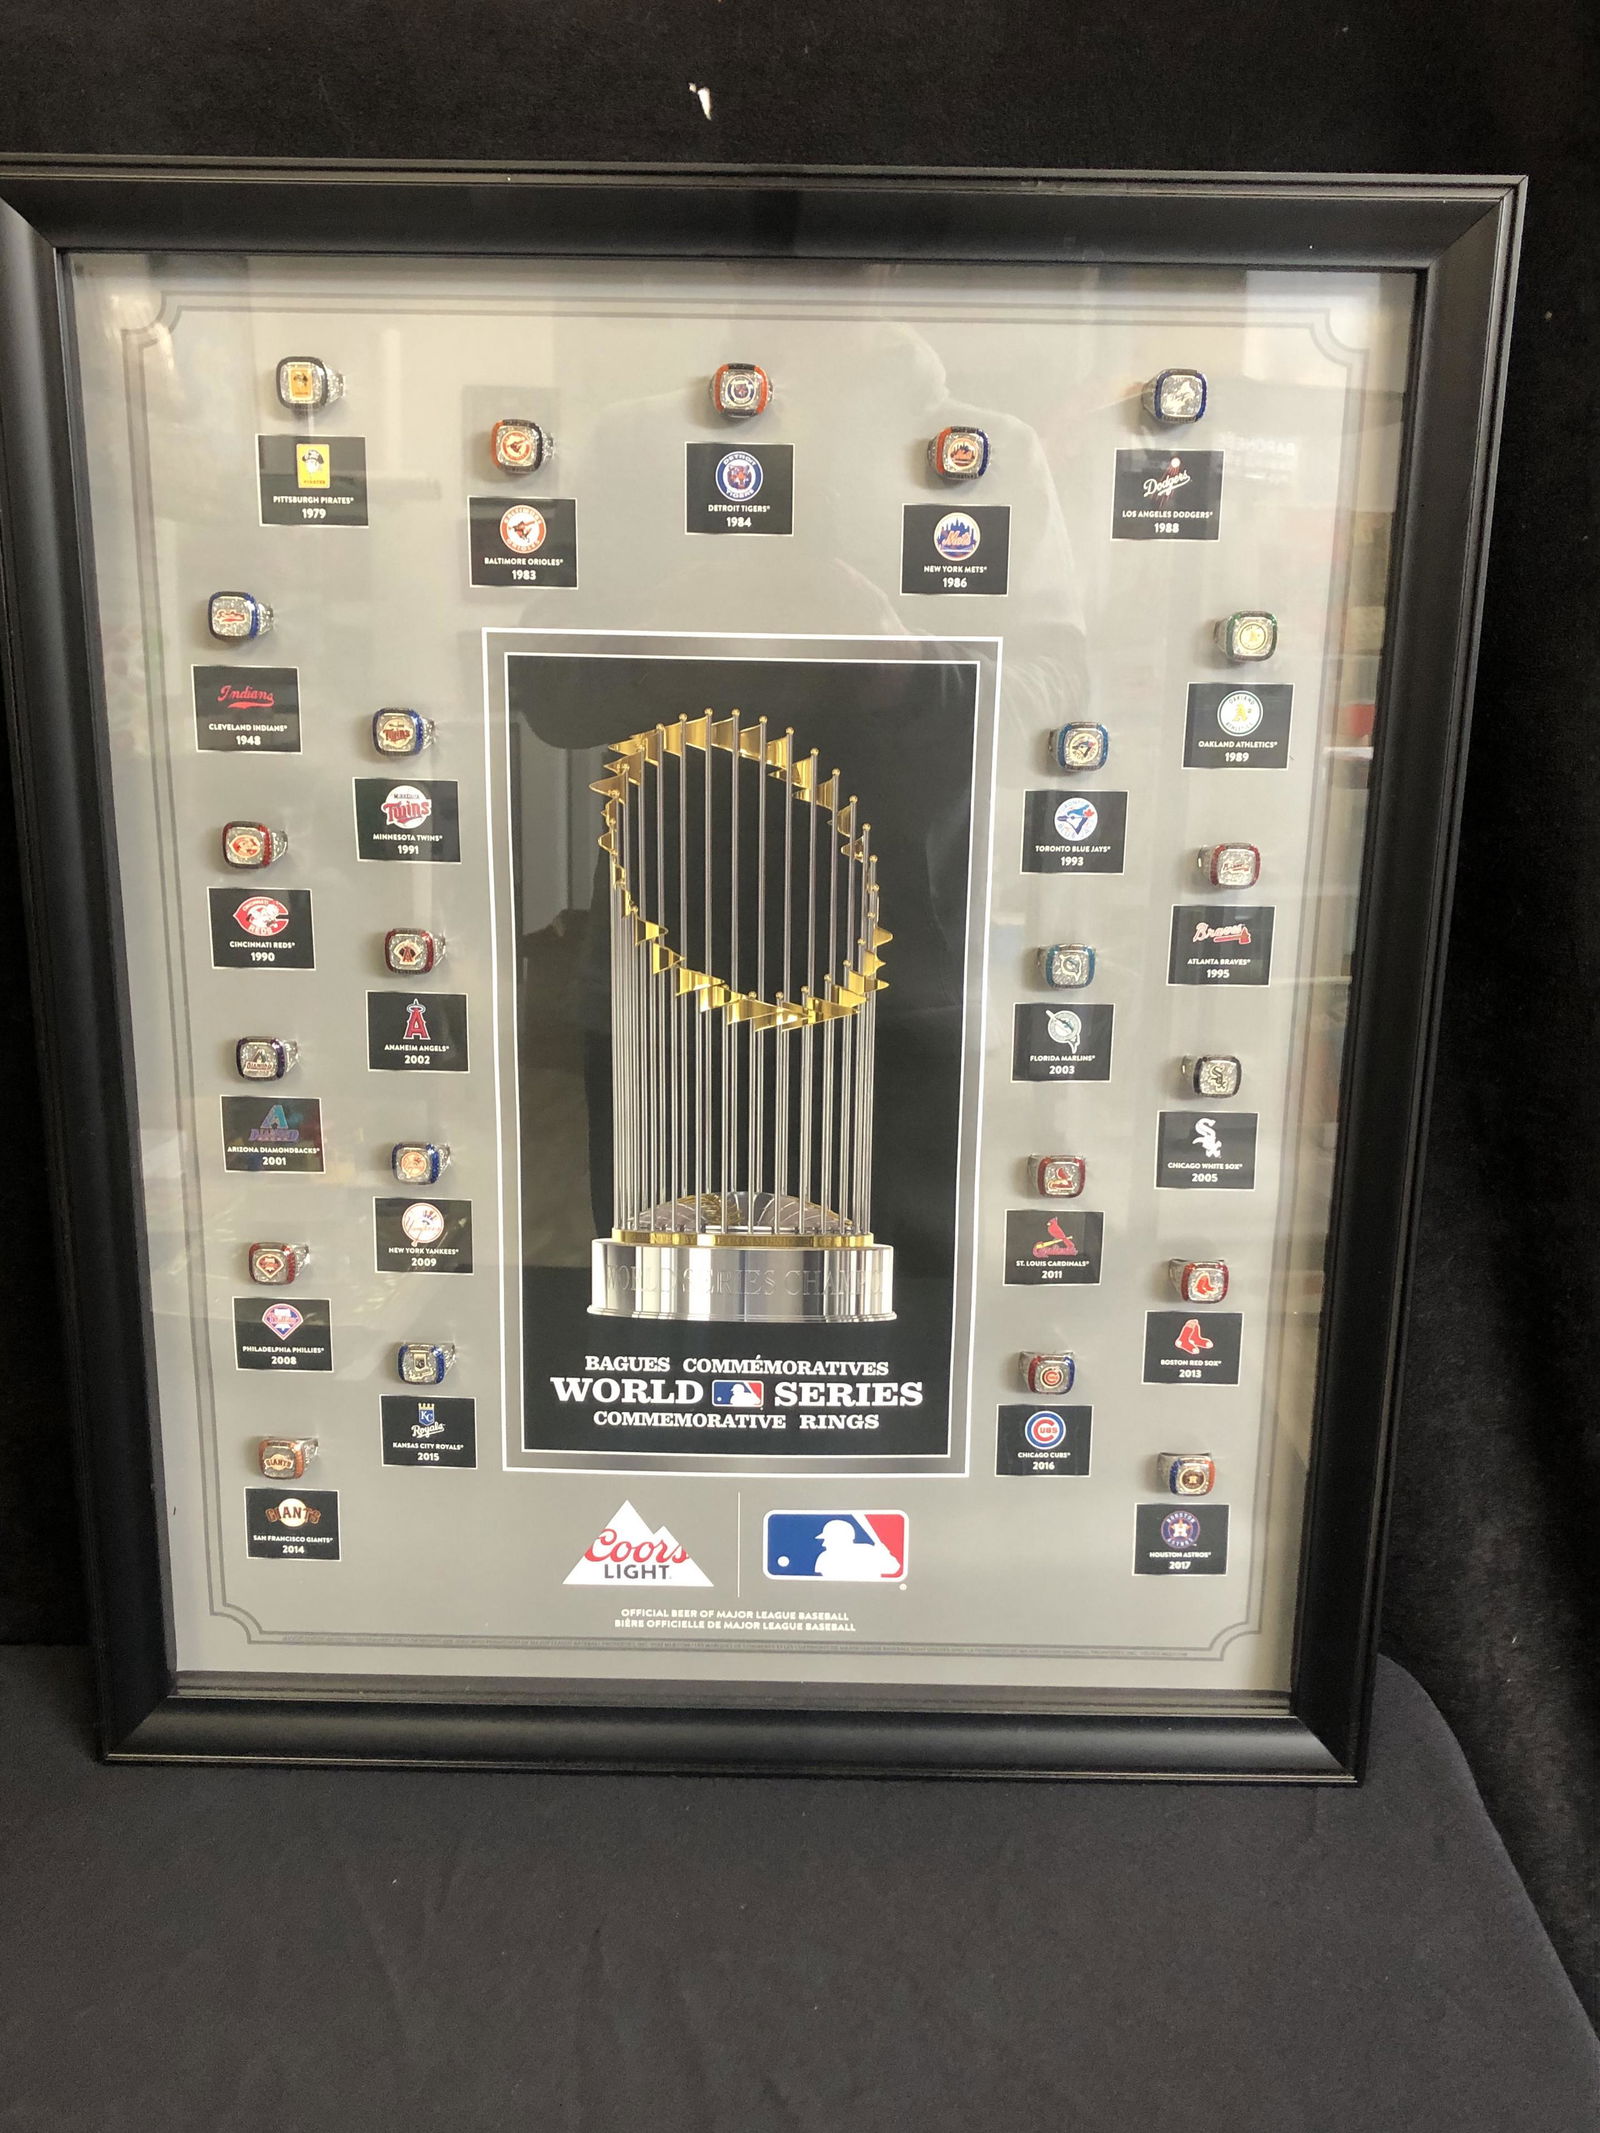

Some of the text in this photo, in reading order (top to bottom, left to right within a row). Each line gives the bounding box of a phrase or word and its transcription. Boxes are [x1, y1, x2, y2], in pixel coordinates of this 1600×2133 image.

[273, 496, 319, 504] PITTSBURGH
[302, 508, 326, 519] 1979
[727, 517, 752, 527] 1984
[1154, 523, 1179, 533] 1988
[528, 558, 560, 566] ORIOLES
[512, 570, 536, 580] 1983
[943, 578, 967, 588] 1986
[253, 724, 284, 732] INDIANS
[236, 735, 261, 745] 1948
[1225, 753, 1249, 762] 1989
[383, 800, 429, 823] Twins
[373, 833, 416, 841] MINNESOTA
[398, 845, 419, 854] 1991
[1061, 857, 1083, 866] 1993
[251, 952, 275, 962] 1990
[1207, 969, 1229, 978] 1995
[405, 1055, 430, 1064] 2002
[1049, 1066, 1075, 1074] 2003
[263, 1157, 286, 1166] 2001
[1192, 1173, 1218, 1182] 2005
[412, 1258, 436, 1267] 2009
[1042, 1271, 1062, 1279] 2011
[272, 1356, 297, 1365] 2008
[584, 1354, 889, 1376] BAGUES COMMÉMORATIVES
[1179, 1370, 1201, 1378] 2013
[550, 1376, 924, 1407] WORLD SERIES
[593, 1411, 880, 1430] COMMEMORATIVE RINGS
[411, 1421, 445, 1439] Royals
[418, 1453, 439, 1461] 2015
[1033, 1462, 1055, 1470] 2016
[265, 1505, 321, 1524] GIANTS
[584, 1528, 690, 1564] Coors
[604, 1563, 671, 1580] LIGHT
[621, 1608, 849, 1621] OFFICIAL BEER OF MAJOR LEAGUE BASEBALL
[615, 1617, 856, 1632] BIÈRE OFFICIELLE DE MAJOR LEAGUE BASEBALL
